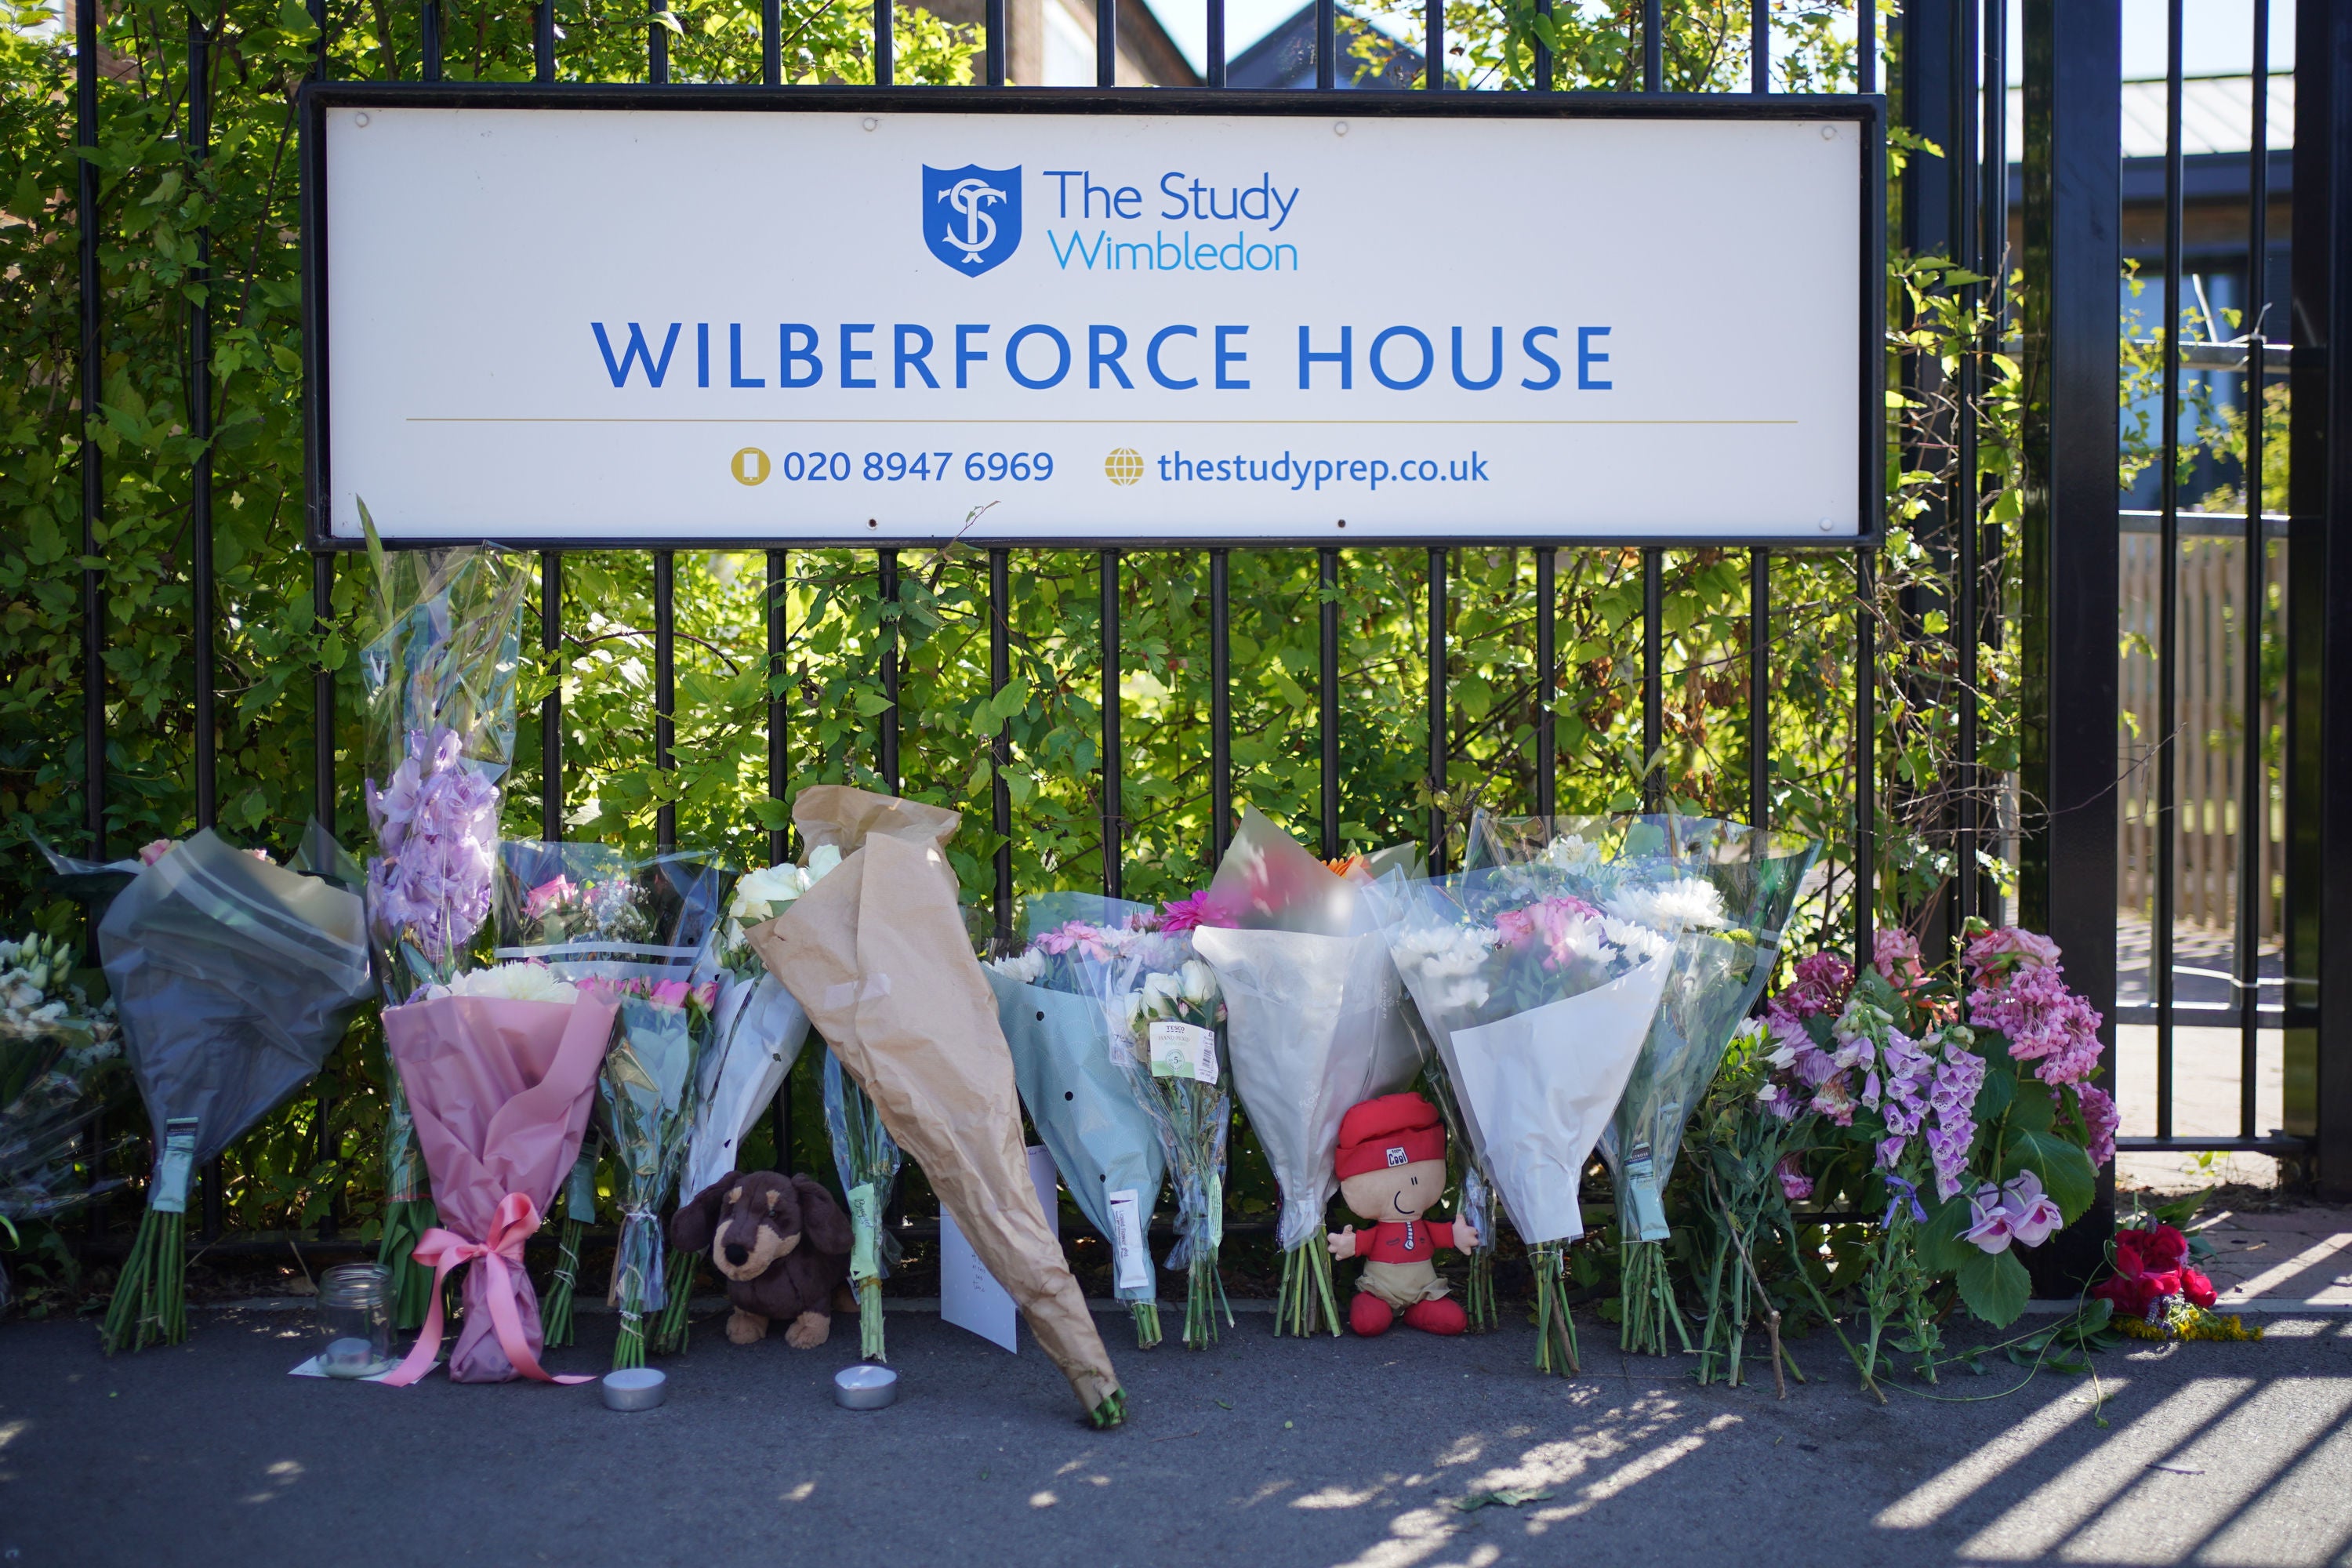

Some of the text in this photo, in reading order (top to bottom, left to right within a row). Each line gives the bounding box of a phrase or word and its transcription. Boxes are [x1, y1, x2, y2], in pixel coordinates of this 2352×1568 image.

[1043, 170, 1300, 232] The Study
[1047, 229, 1298, 271] Wimbledon
[590, 321, 1613, 392] WILBERFORCE HOUSE
[784, 451, 1054, 481] 020 8947 6969
[1156, 450, 1490, 492] thestudyprep.co.uk
[1173, 1056, 1179, 1065] 5
[1388, 1152, 1406, 1165] Cool
